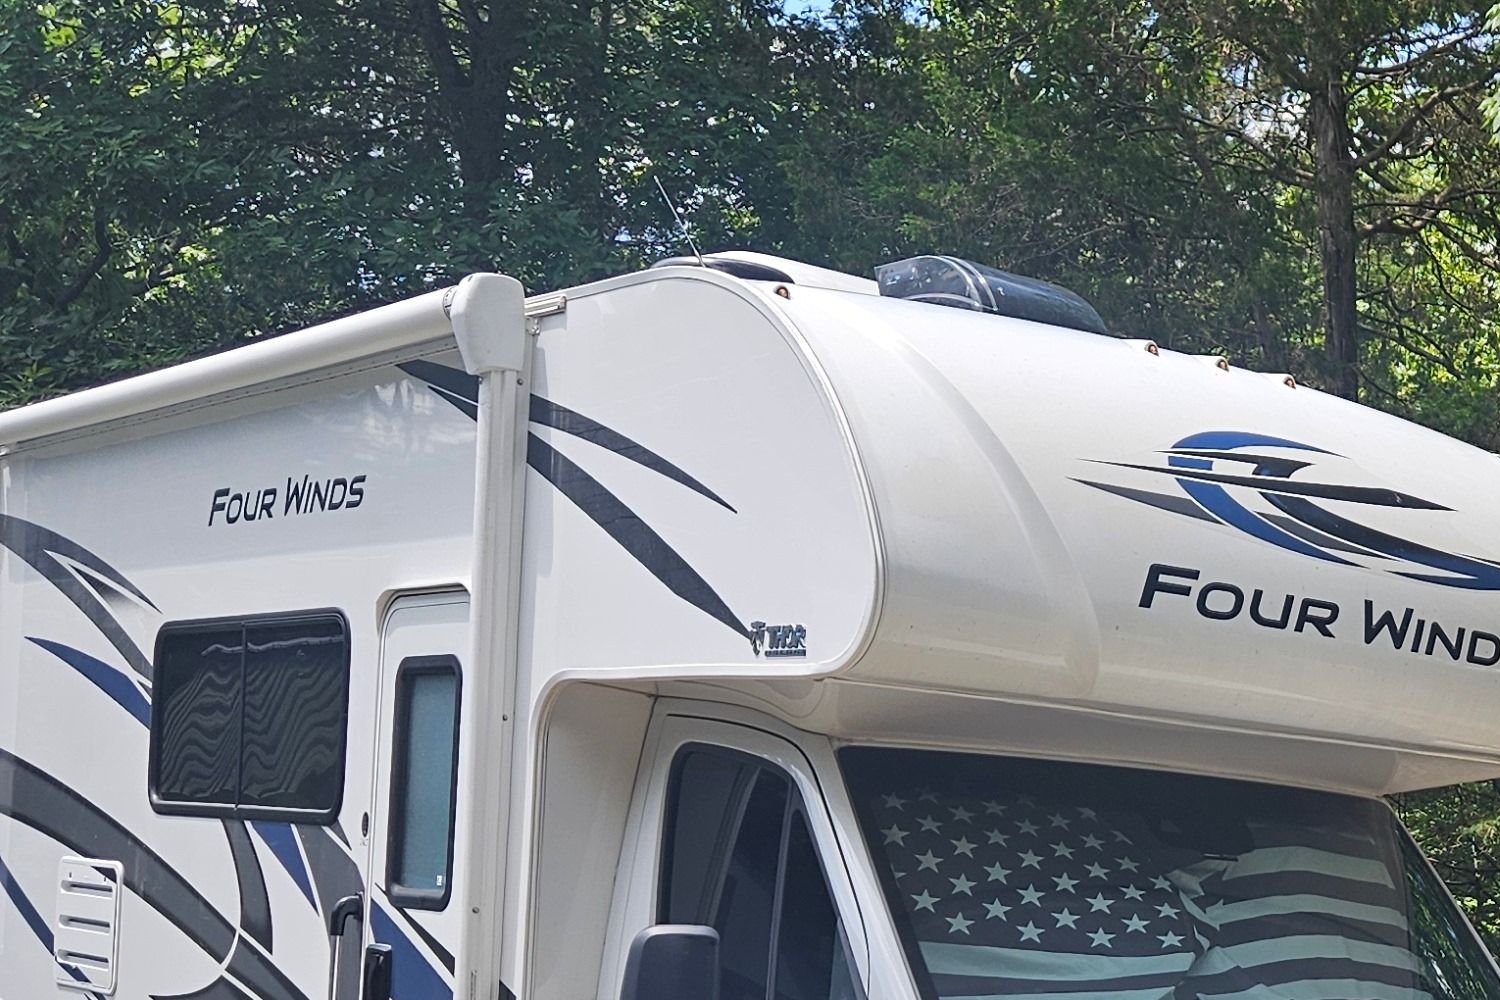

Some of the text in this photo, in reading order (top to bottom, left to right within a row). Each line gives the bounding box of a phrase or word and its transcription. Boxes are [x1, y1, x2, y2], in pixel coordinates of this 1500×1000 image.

[208, 474, 367, 527] FOUR WINDS
[1138, 563, 1340, 639] FOUR
